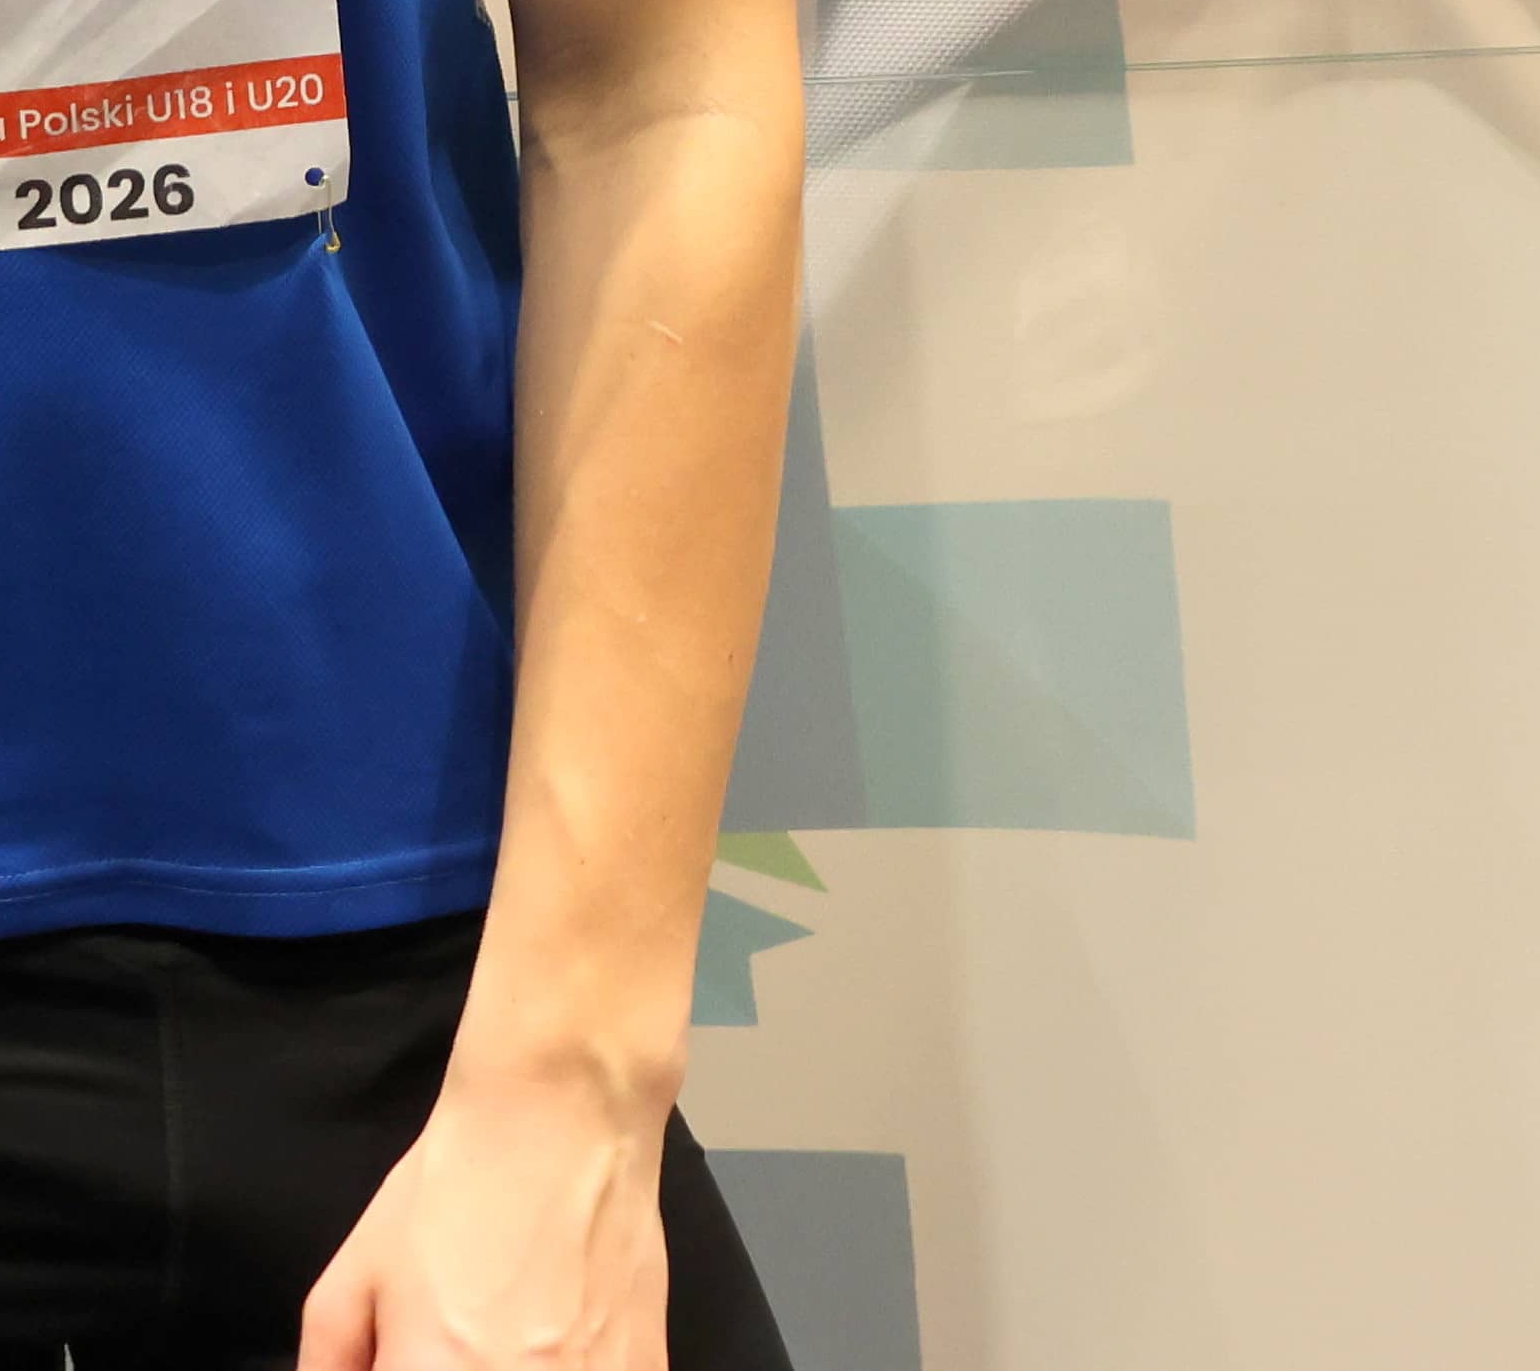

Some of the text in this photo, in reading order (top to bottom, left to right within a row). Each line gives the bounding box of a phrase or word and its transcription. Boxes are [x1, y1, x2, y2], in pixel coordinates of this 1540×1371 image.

[18, 94, 134, 141] Polski
[146, 85, 214, 124] U18
[225, 80, 237, 115] i
[247, 72, 325, 112] U20
[14, 163, 195, 231] 2026
